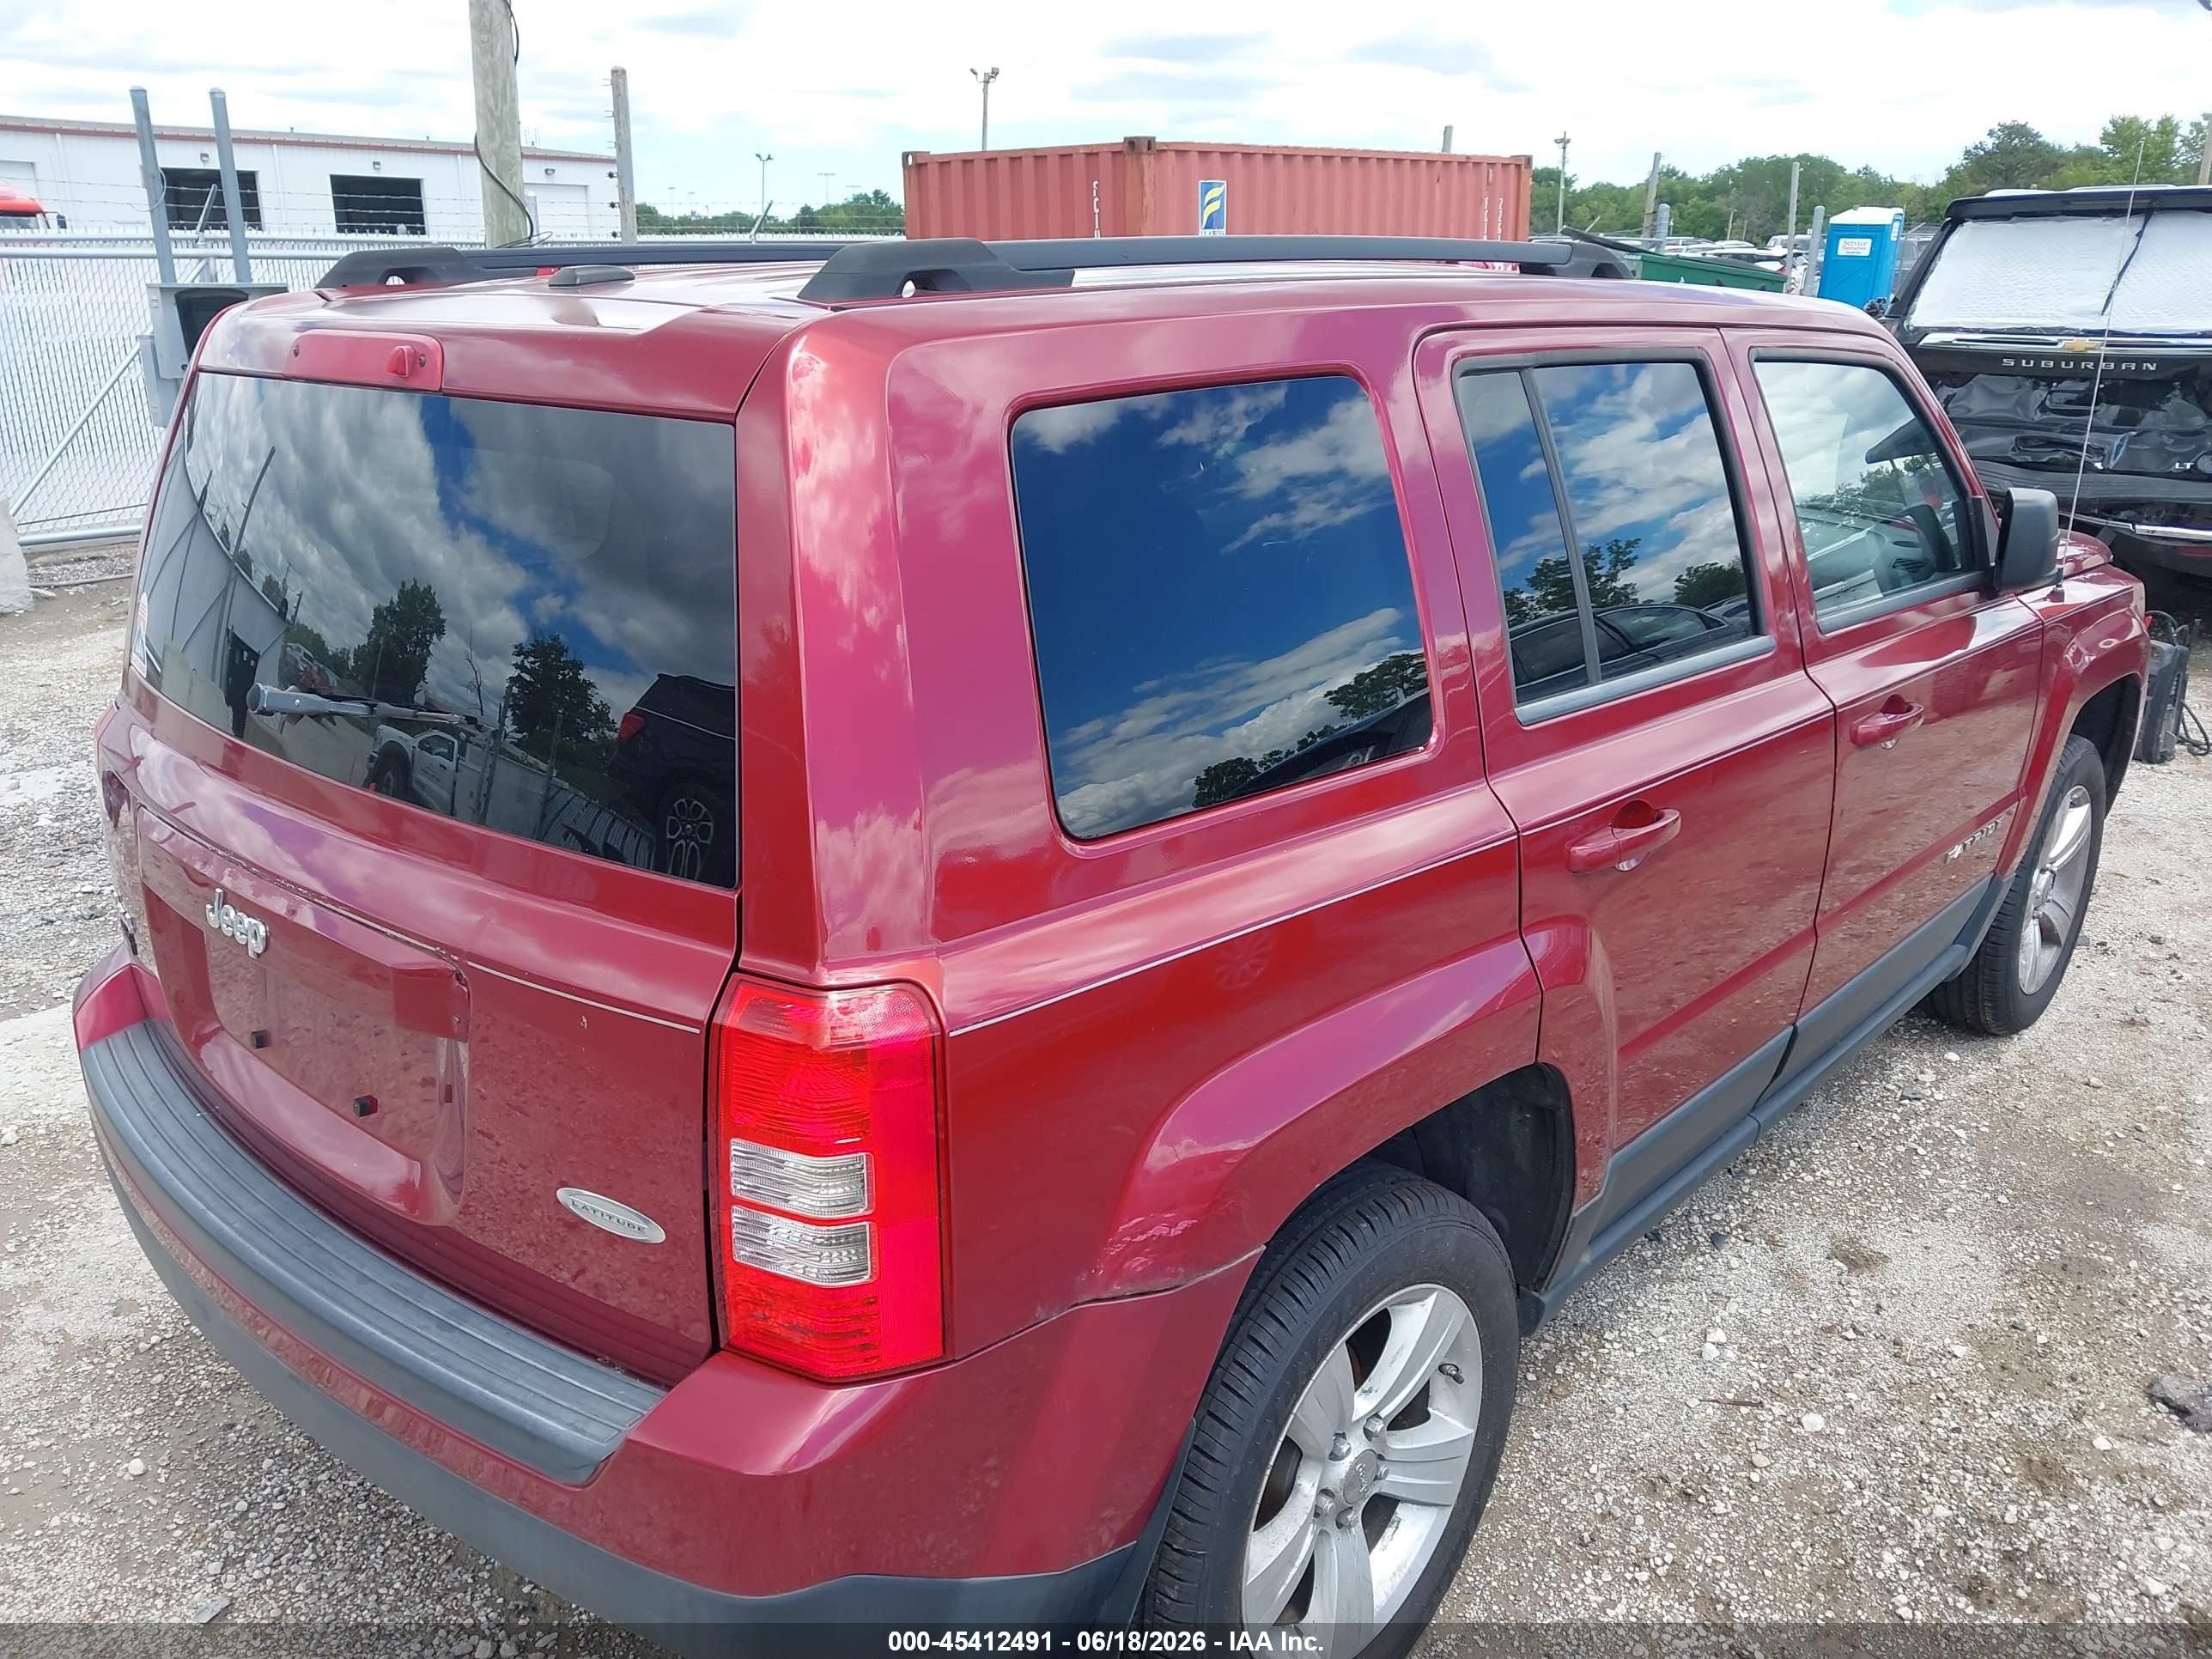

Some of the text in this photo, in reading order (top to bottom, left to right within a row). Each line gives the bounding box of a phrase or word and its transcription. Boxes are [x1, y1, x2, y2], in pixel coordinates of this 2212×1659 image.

[2002, 358, 2158, 371] SUBURBAN
[205, 888, 267, 960] Jeep
[571, 1200, 646, 1233] LATITUDE
